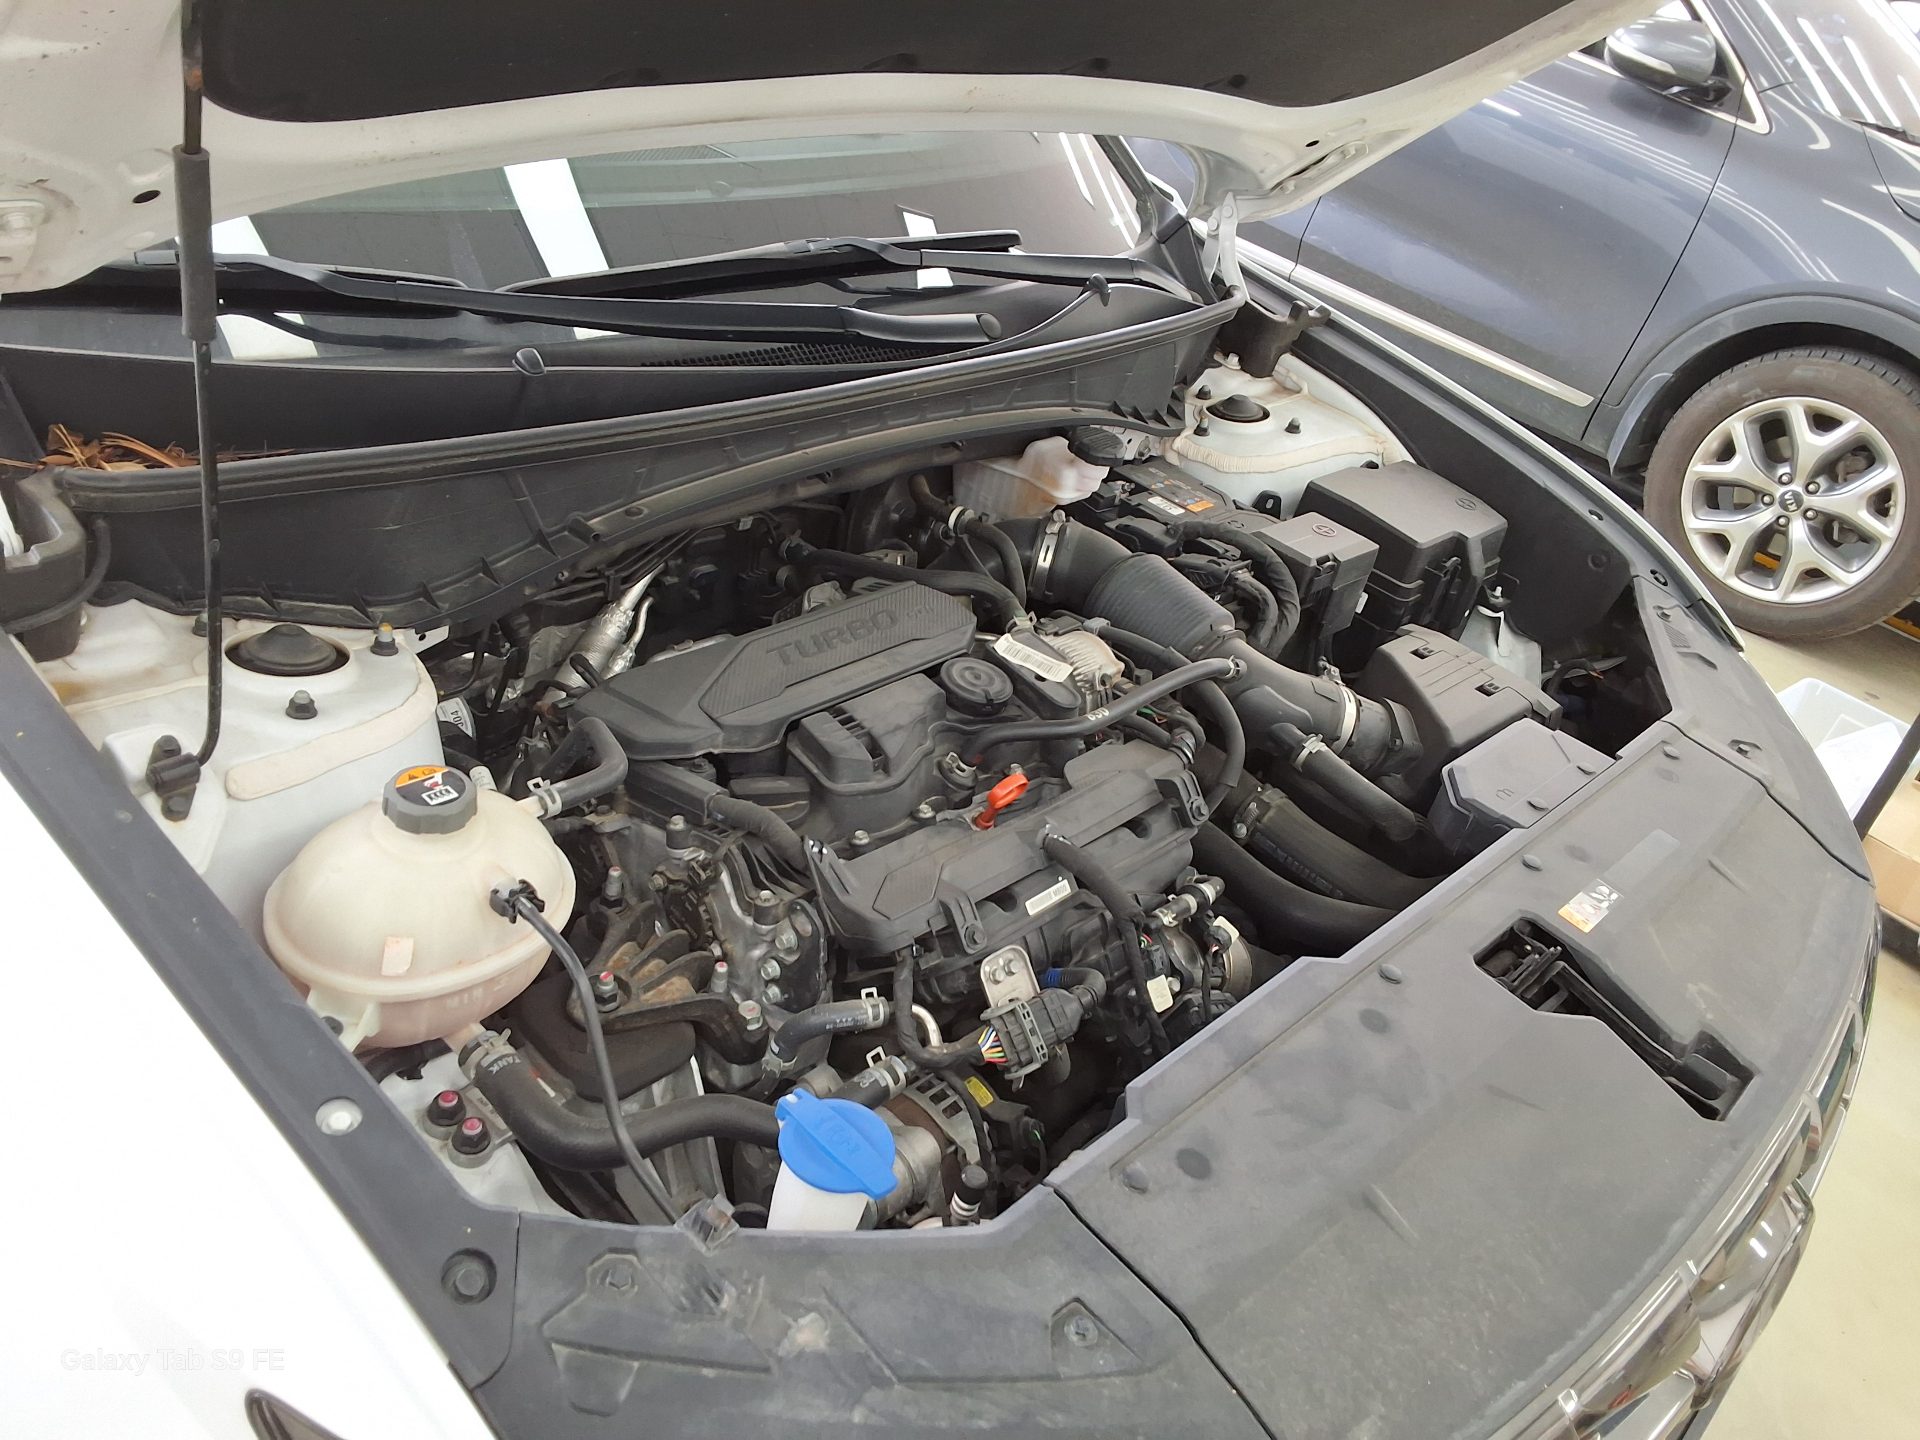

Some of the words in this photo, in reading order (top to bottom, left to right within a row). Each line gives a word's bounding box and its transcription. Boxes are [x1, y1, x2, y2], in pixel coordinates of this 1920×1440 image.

[1784, 491, 1798, 512] KIA
[766, 608, 899, 667] TURBO
[487, 1055, 522, 1075] TANK
